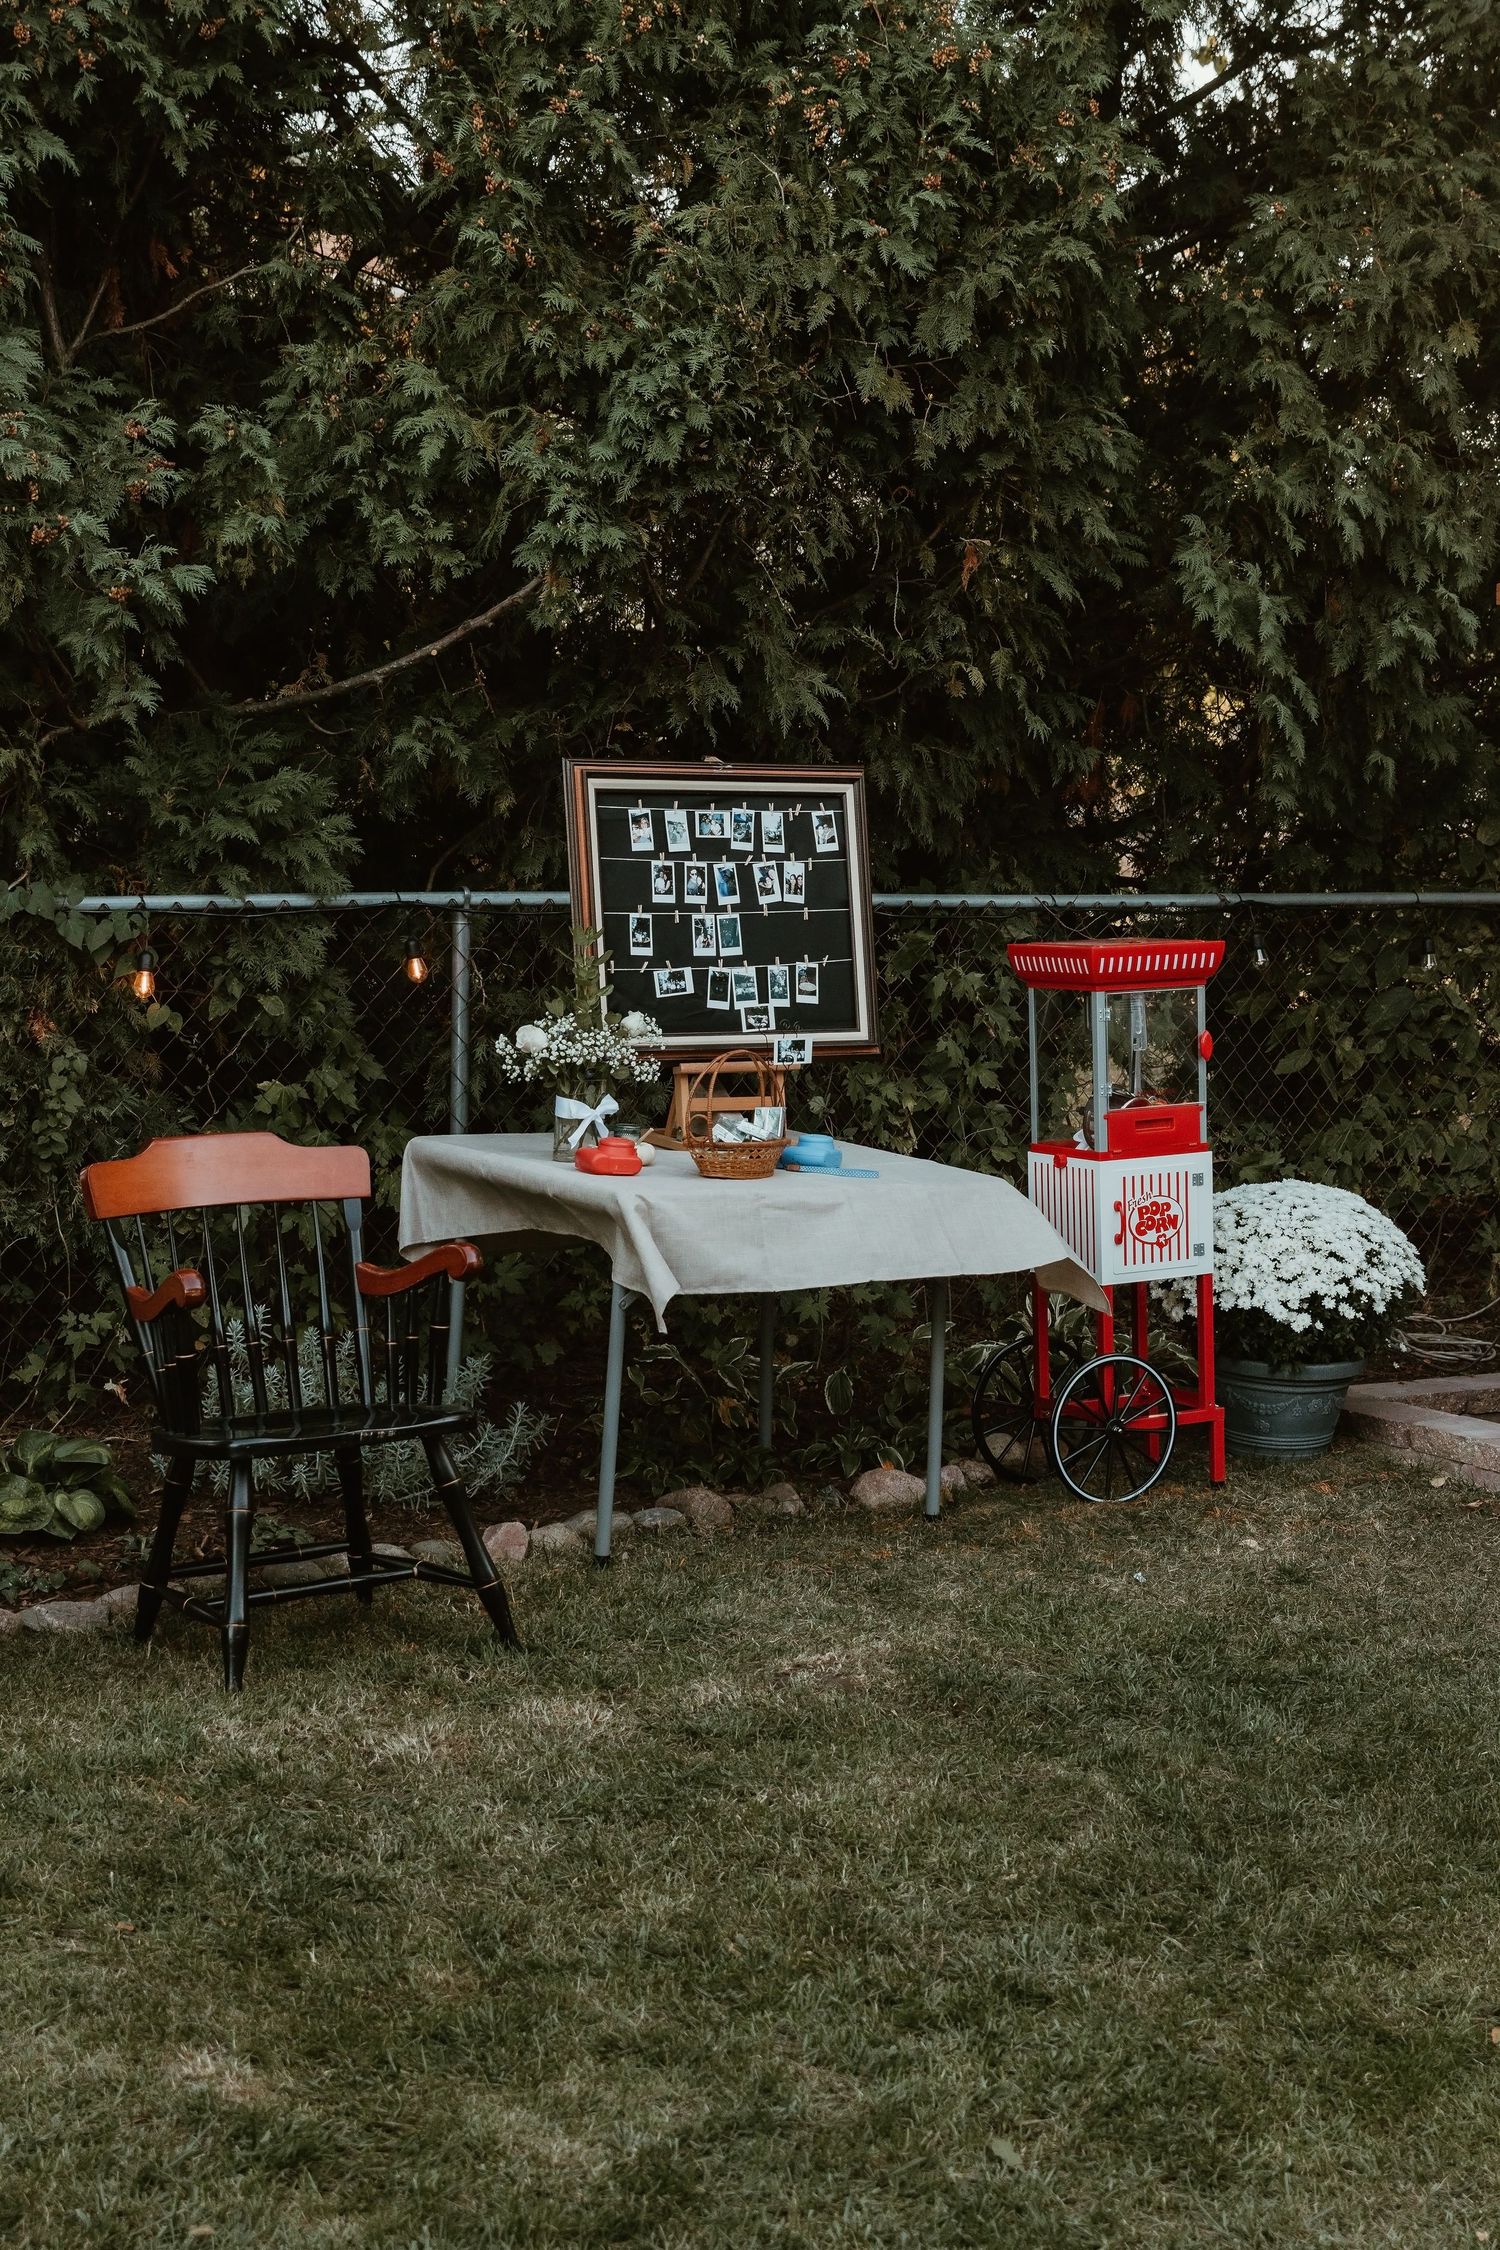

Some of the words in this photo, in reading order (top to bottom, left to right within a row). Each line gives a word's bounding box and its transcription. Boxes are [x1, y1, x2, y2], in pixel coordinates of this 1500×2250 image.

[1127, 1191, 1153, 1211] Fresh
[1137, 1200, 1171, 1220] POP
[1135, 1214, 1178, 1236] CORN
